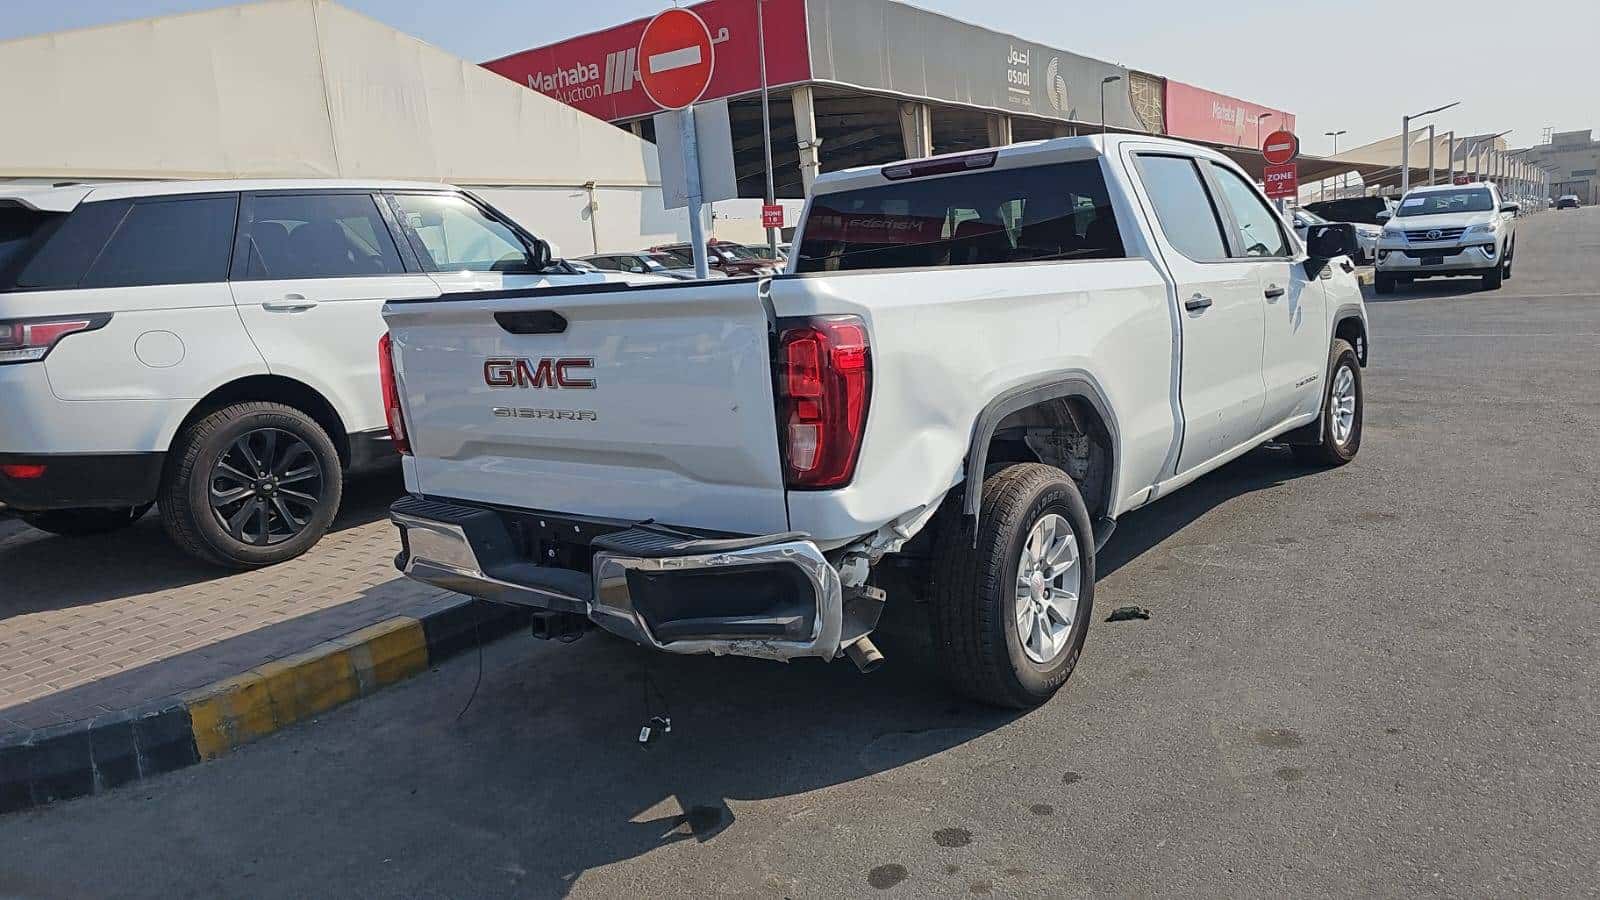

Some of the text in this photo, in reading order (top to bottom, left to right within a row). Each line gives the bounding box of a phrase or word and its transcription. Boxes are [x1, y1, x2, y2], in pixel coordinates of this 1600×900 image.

[527, 61, 600, 92] Marhaba
[1008, 69, 1030, 87] asool
[555, 84, 602, 104] Auction
[1267, 172, 1294, 182] ZONE
[1277, 182, 1284, 190] 2
[484, 357, 597, 389] GMC
[493, 407, 597, 421] SIERRA
